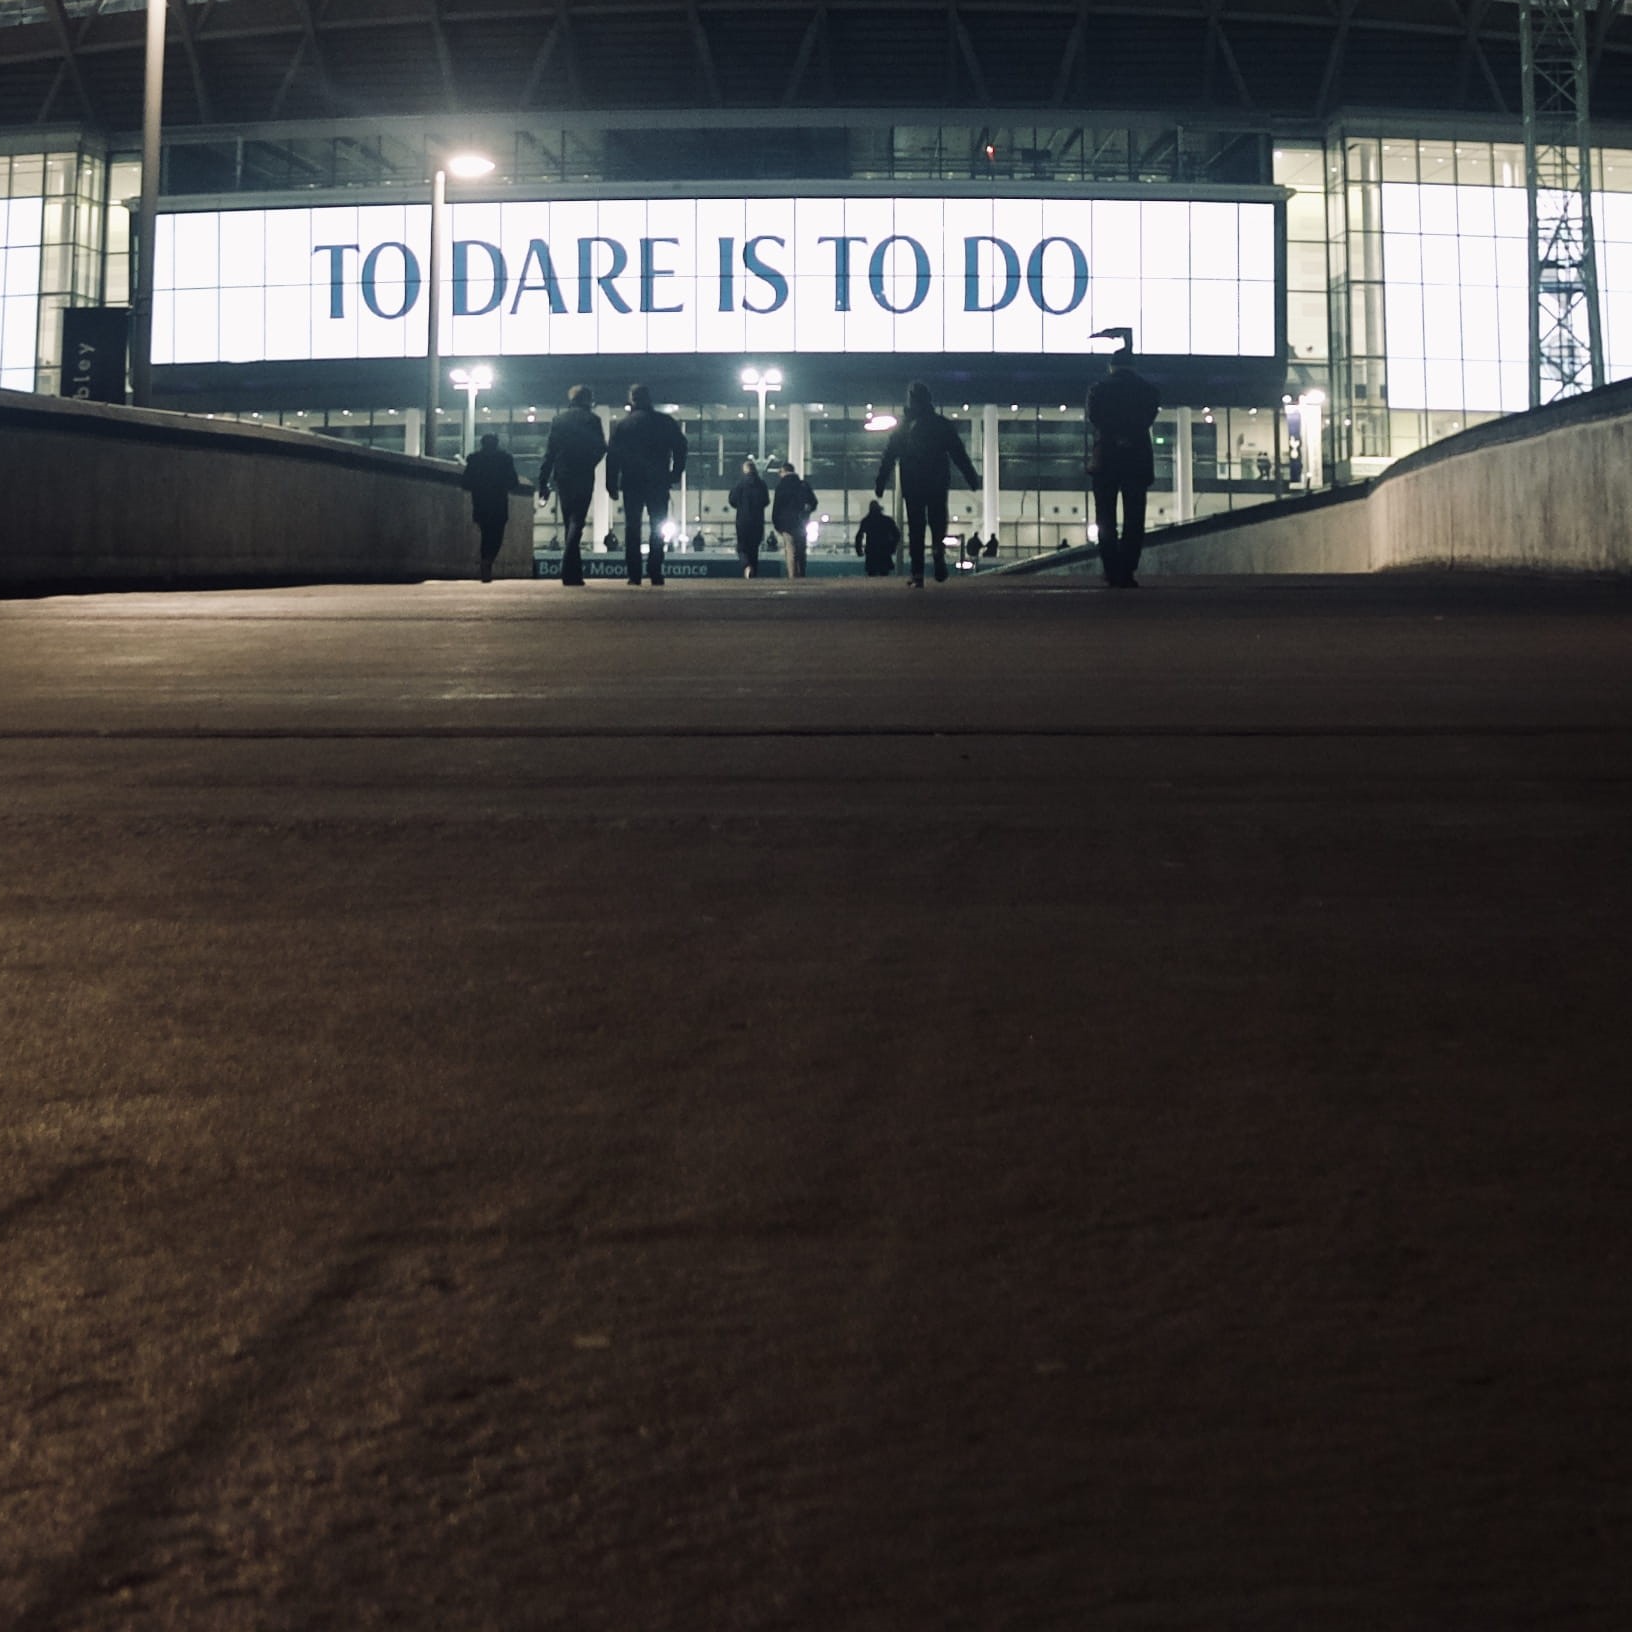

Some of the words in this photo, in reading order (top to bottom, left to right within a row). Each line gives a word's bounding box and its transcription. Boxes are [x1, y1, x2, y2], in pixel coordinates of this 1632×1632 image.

[311, 241, 421, 320] TO
[452, 236, 684, 317] DARE
[718, 235, 789, 315] IS
[817, 234, 931, 315] TO
[963, 235, 1089, 316] DO
[641, 561, 708, 576] Etrance
